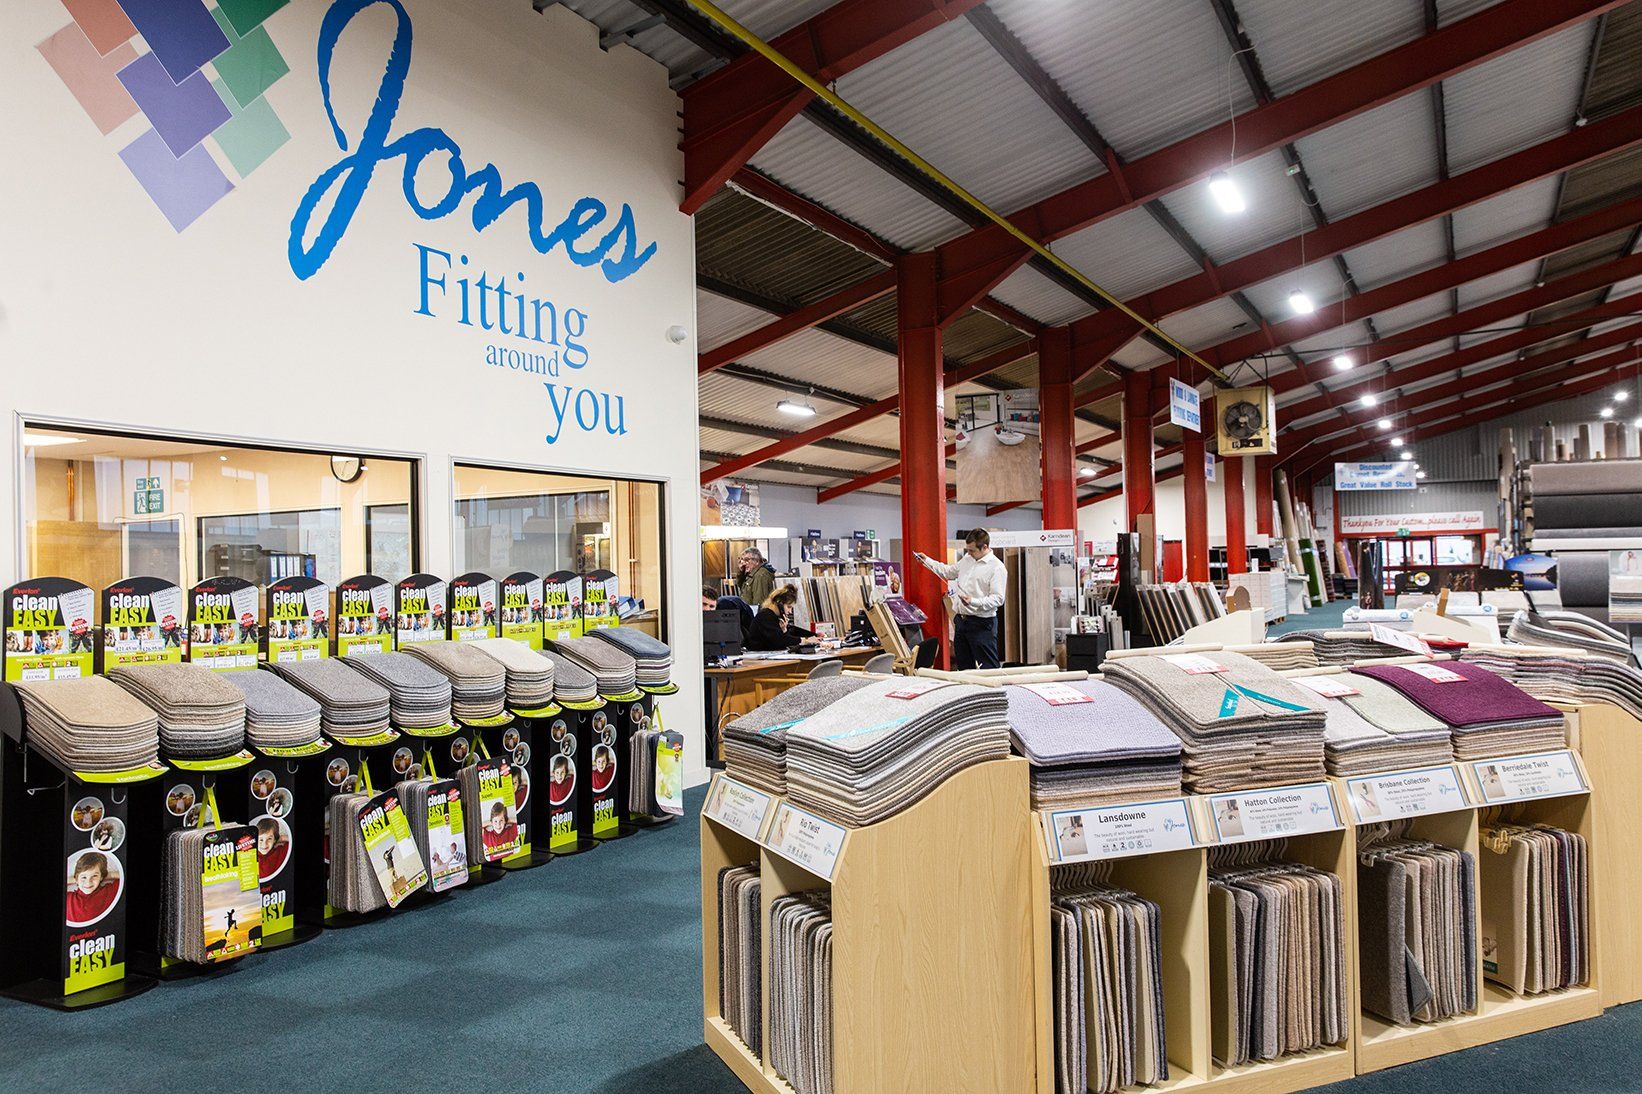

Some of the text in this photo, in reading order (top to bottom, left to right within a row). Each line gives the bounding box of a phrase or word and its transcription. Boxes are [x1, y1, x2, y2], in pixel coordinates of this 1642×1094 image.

[288, 0, 656, 283] Jones
[412, 243, 589, 369] Fitting
[486, 342, 561, 378] around
[544, 382, 628, 444] you
[1374, 518, 1384, 526] For
[454, 586, 478, 596] clean
[504, 584, 526, 594] clean
[546, 582, 566, 592] clean
[586, 580, 604, 590] clean
[196, 592, 230, 606] clean
[273, 590, 304, 604] clean
[342, 589, 370, 602] clean
[400, 587, 426, 599] clean
[505, 594, 526, 606] EASY
[546, 592, 566, 604] EASY
[586, 590, 604, 600] EASY
[12, 594, 58, 610] clean
[110, 593, 150, 608] clean
[342, 600, 370, 614] EASY
[401, 598, 426, 612] EASY
[455, 596, 478, 608] EASY
[110, 607, 150, 624] EASY
[196, 606, 230, 622] EASY
[274, 603, 304, 618] EASY
[13, 610, 58, 627] EASY
[479, 768, 499, 780] clean
[1502, 763, 1532, 772] Berriedale
[480, 778, 500, 791] EASY
[1378, 777, 1430, 788] Brisbane Collection
[428, 794, 447, 807] clean
[594, 798, 614, 811] clean
[1244, 794, 1302, 807] Hatton Collection
[360, 806, 385, 828] clean
[428, 804, 445, 818] EASY
[552, 811, 572, 825] clean
[594, 808, 614, 822] EASY
[1098, 810, 1146, 824] Lansdowne
[362, 816, 386, 837] EASY
[552, 821, 572, 836] EASY
[808, 821, 820, 834] Twist
[204, 842, 234, 858] clean
[204, 852, 234, 872] EASY
[260, 890, 286, 908] lean
[70, 934, 115, 959] clean
[70, 947, 115, 976] EASY
